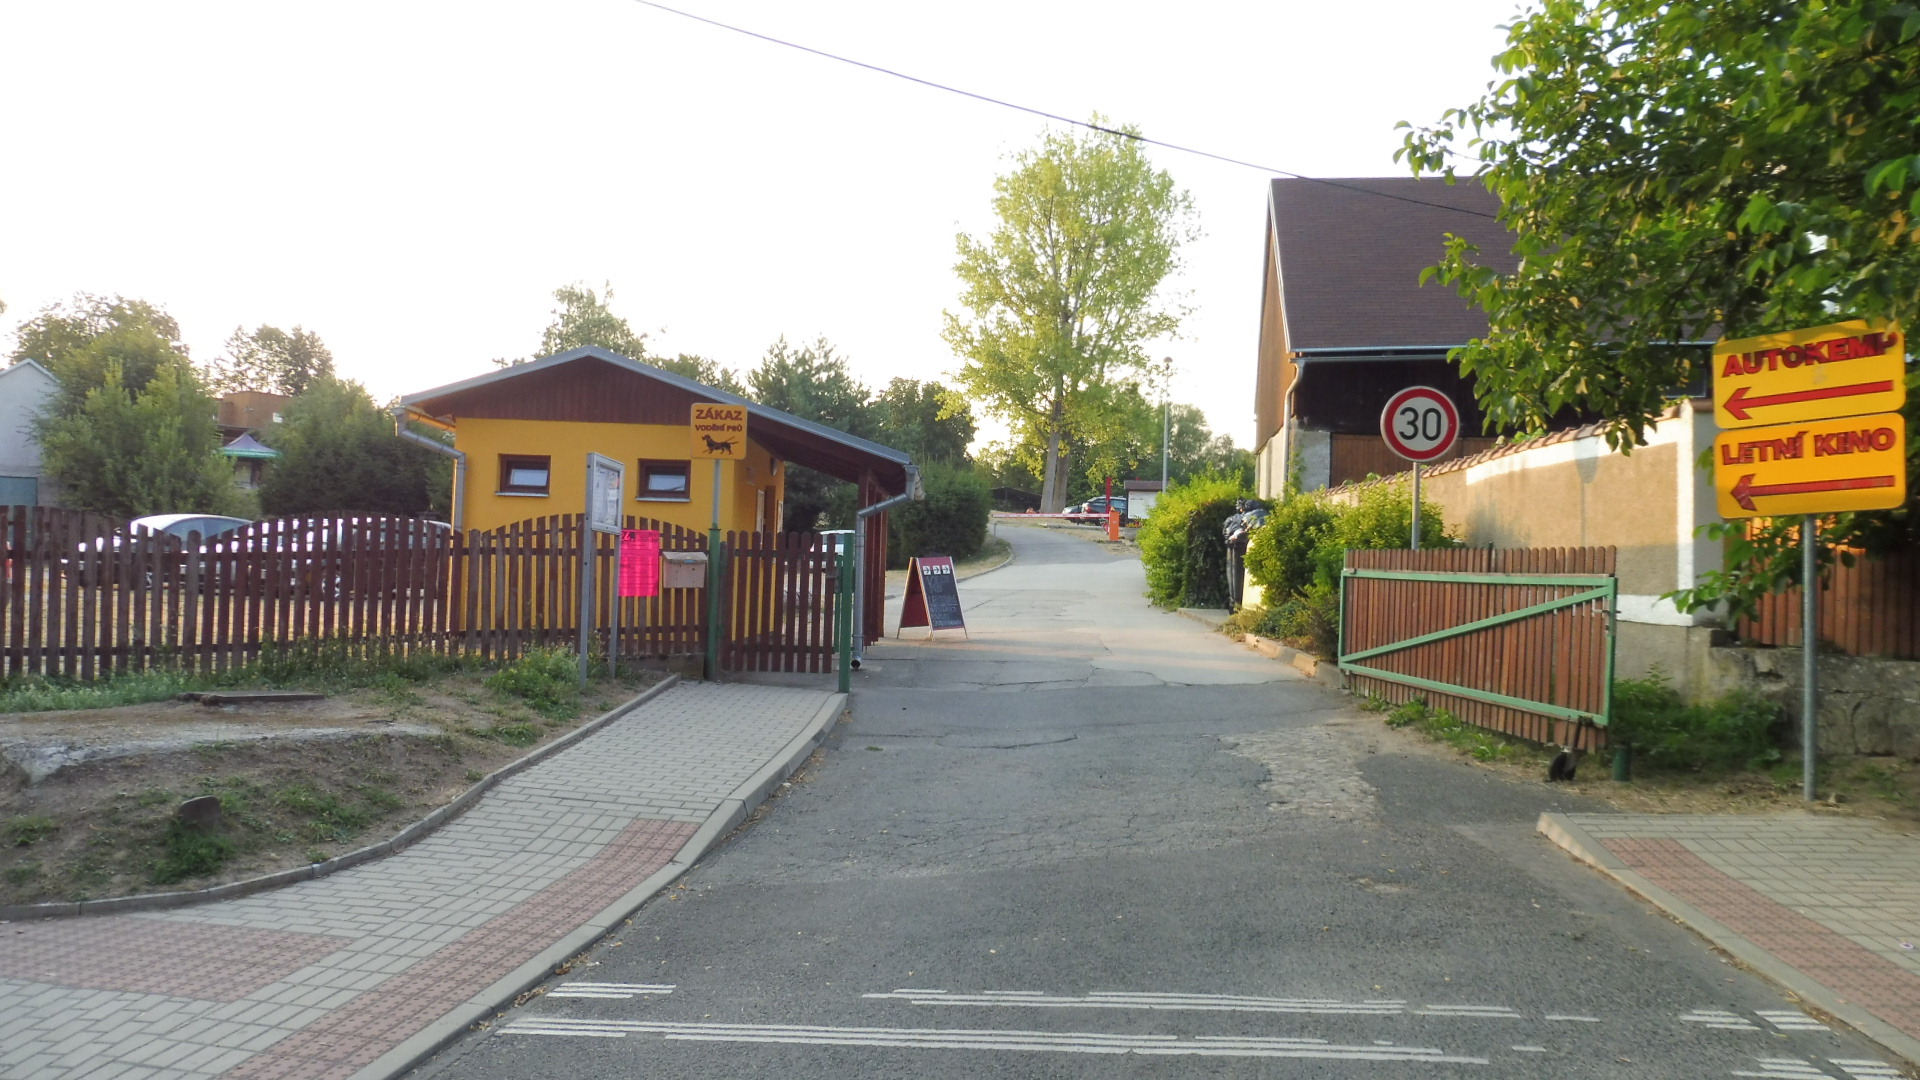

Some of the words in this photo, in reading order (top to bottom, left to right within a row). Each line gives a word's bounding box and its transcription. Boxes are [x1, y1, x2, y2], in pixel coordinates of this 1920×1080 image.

[696, 407, 742, 421] ZÁKAZ
[1399, 407, 1441, 441] 30
[1722, 430, 1809, 465] LETNÍ
[1814, 427, 1896, 457] KINO
